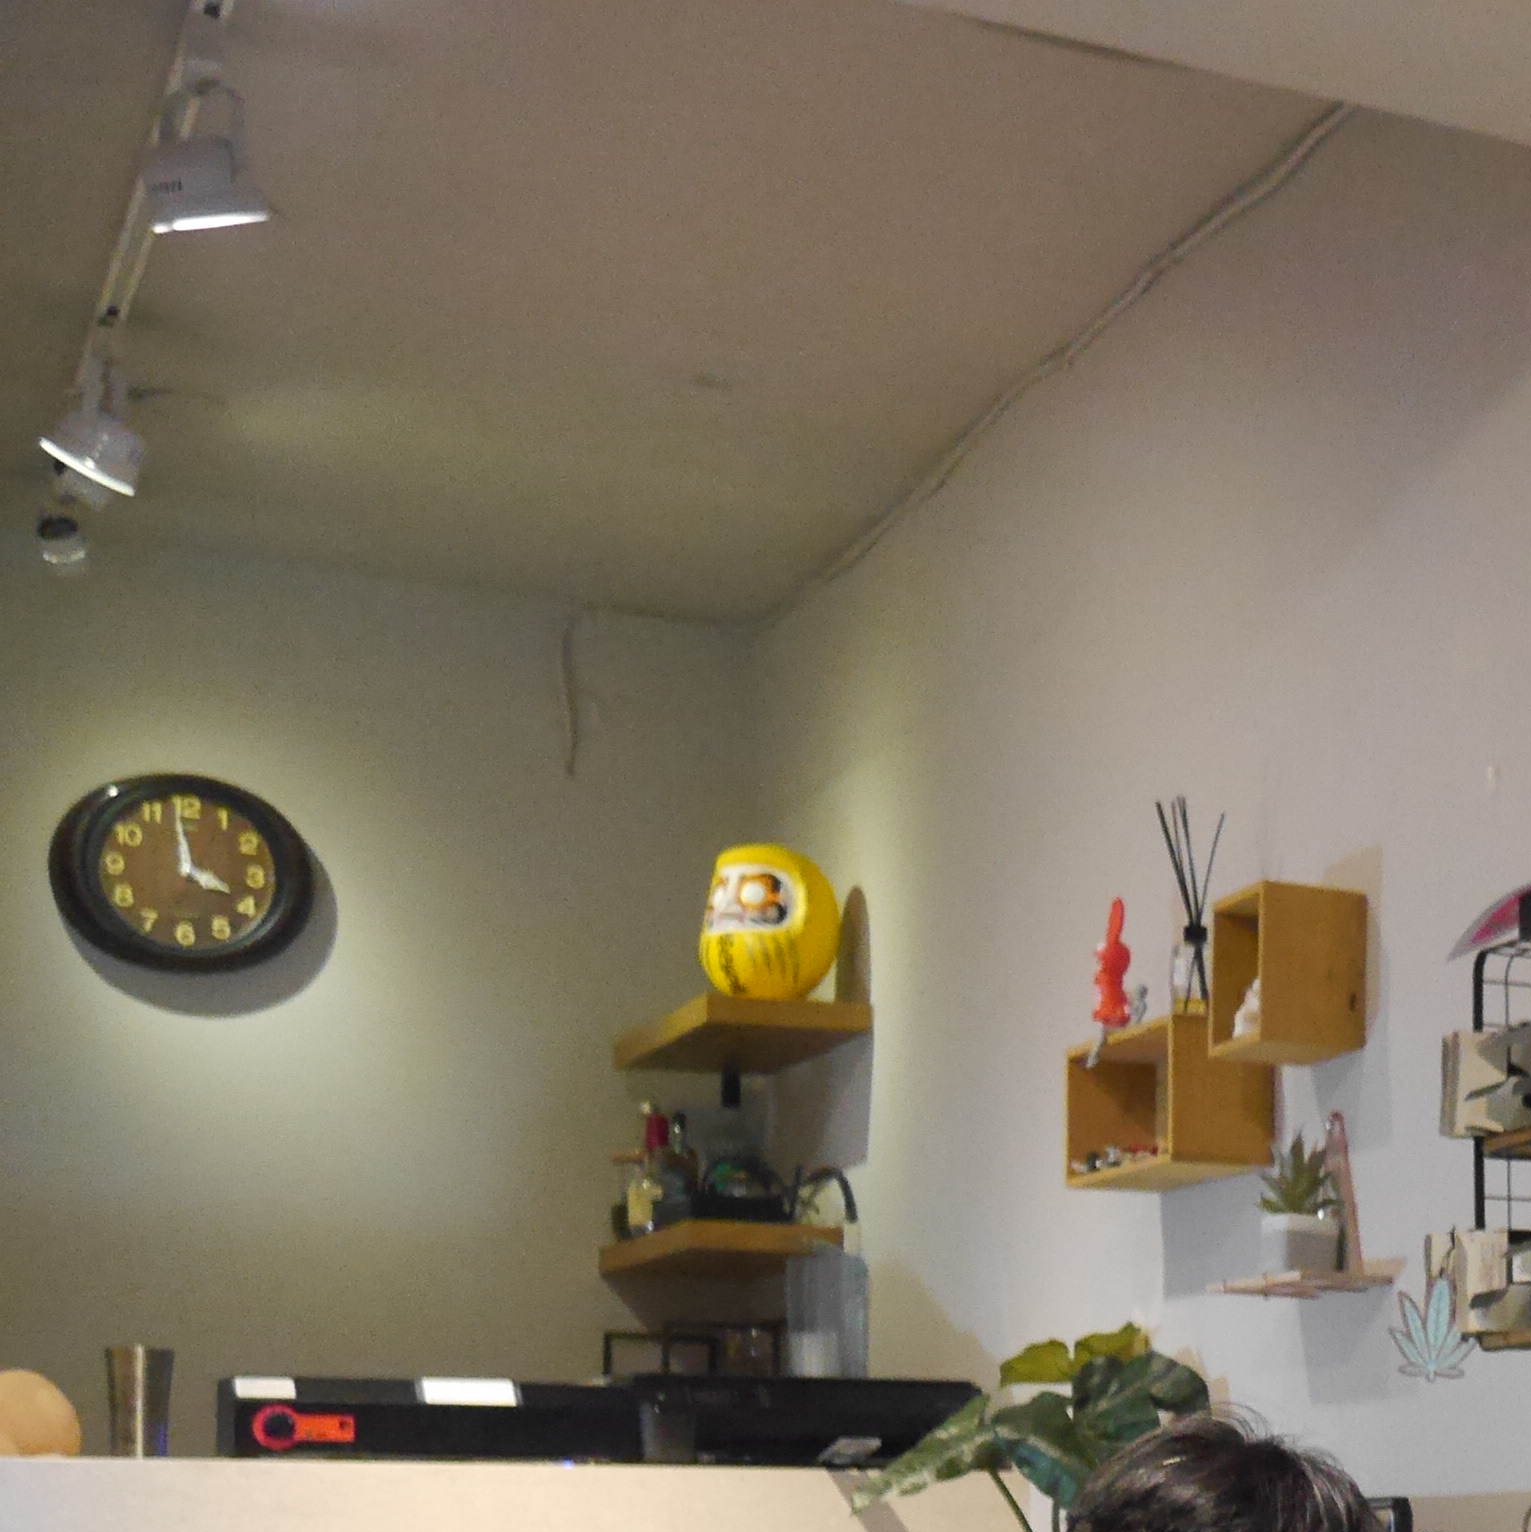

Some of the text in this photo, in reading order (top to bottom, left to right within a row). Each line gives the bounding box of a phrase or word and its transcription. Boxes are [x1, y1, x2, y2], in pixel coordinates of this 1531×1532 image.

[141, 801, 162, 824] 11
[218, 807, 228, 831] 1
[115, 822, 142, 847] 10
[239, 831, 259, 856] 2
[105, 851, 125, 876] 9
[236, 895, 256, 919] 4
[141, 907, 158, 933] 7
